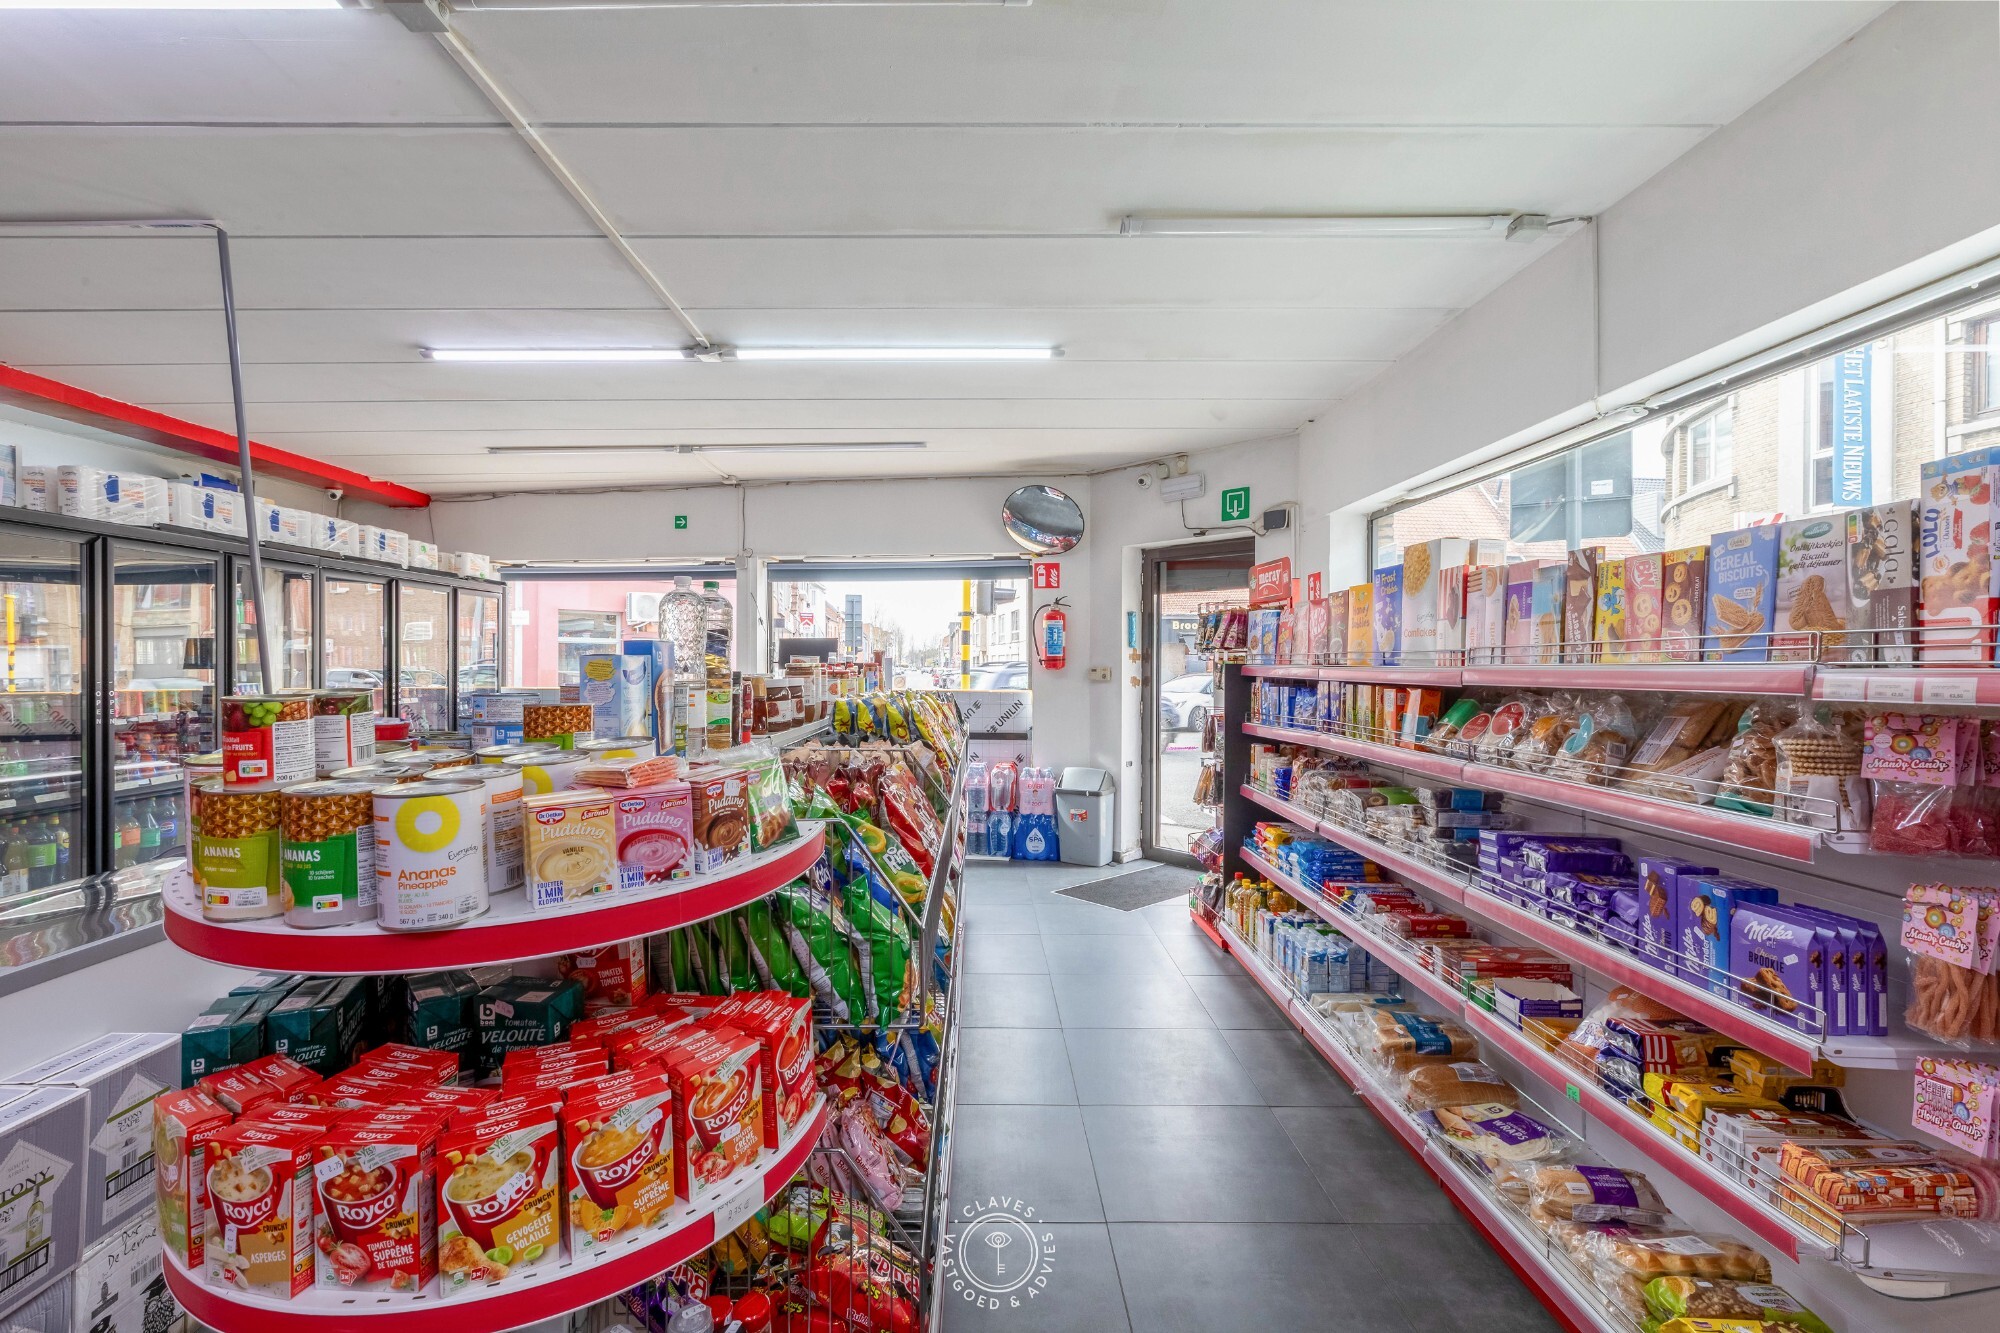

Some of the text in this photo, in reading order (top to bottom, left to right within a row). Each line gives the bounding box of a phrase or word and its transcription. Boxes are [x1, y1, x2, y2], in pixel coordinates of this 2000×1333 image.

[1842, 379, 1865, 443] LAATSTE
[1841, 445, 1865, 501] NIEUWS
[1923, 508, 1942, 559] LULU
[1884, 519, 1905, 573] Gala
[1665, 552, 1675, 563] 25
[1713, 551, 1758, 573] CEREAL
[1800, 551, 1830, 562] Biscuits
[1806, 558, 1843, 569] déjeuner
[1258, 568, 1282, 586] meray
[1718, 565, 1763, 584] BISCUITS
[108, 690, 116, 725] OPEN
[995, 699, 1024, 728] UNILIN
[231, 743, 254, 751] FRUITS
[1867, 757, 1950, 773] Mandy Candy
[661, 796, 688, 810] Saroma
[707, 795, 745, 814] Pudding
[581, 806, 610, 821] Saroma
[623, 812, 684, 830] Pudding
[540, 823, 606, 842] Pudding
[204, 846, 241, 858] ANANAS
[283, 850, 321, 862] ANANAS
[447, 844, 479, 861] Everyday
[562, 846, 585, 854] VANILLE
[314, 869, 335, 877] schijven
[398, 866, 457, 881] Ananas
[619, 866, 644, 874] FOUETTER
[620, 871, 644, 883] 1 MIN
[398, 879, 449, 891] Pineapple
[536, 880, 564, 889] FOUETTER
[620, 881, 645, 890] KLOPPEN
[537, 887, 564, 900] 1 MIN
[538, 897, 564, 906] KLOPPEN
[1743, 920, 1795, 943] Milka
[1904, 926, 1971, 953] Mandy Candy
[1684, 926, 1700, 974] Milka
[1754, 946, 1778, 961] Choco
[1748, 949, 1785, 974] BROOKIE
[597, 966, 623, 979] TOMATEN
[599, 976, 626, 988] TOMATES
[504, 1018, 541, 1027] tomaten-
[428, 1029, 474, 1051] VELOUTÉ
[481, 1024, 547, 1044] VELOUTÉ
[491, 1045, 503, 1054] de
[117, 1108, 144, 1128] STONY
[119, 1117, 141, 1133] CAPE
[1491, 1118, 1529, 1141] WRAPS
[643, 1154, 672, 1176] CRUNCHY
[0, 1166, 51, 1202] TONY
[523, 1187, 556, 1211] CRUNCHY
[633, 1183, 671, 1209] SUPRÊME
[639, 1204, 646, 1214] DE
[262, 1221, 289, 1234] CRUNCHY
[385, 1216, 415, 1231] CRUNCHY
[506, 1213, 553, 1244] GEVOGELTE
[366, 1239, 396, 1251] TOMATEN
[512, 1227, 551, 1251] VOLAILLE
[250, 1250, 287, 1264] ASPERGES
[372, 1243, 414, 1262] SUPRÊME
[376, 1255, 415, 1270] DE TOMATES
